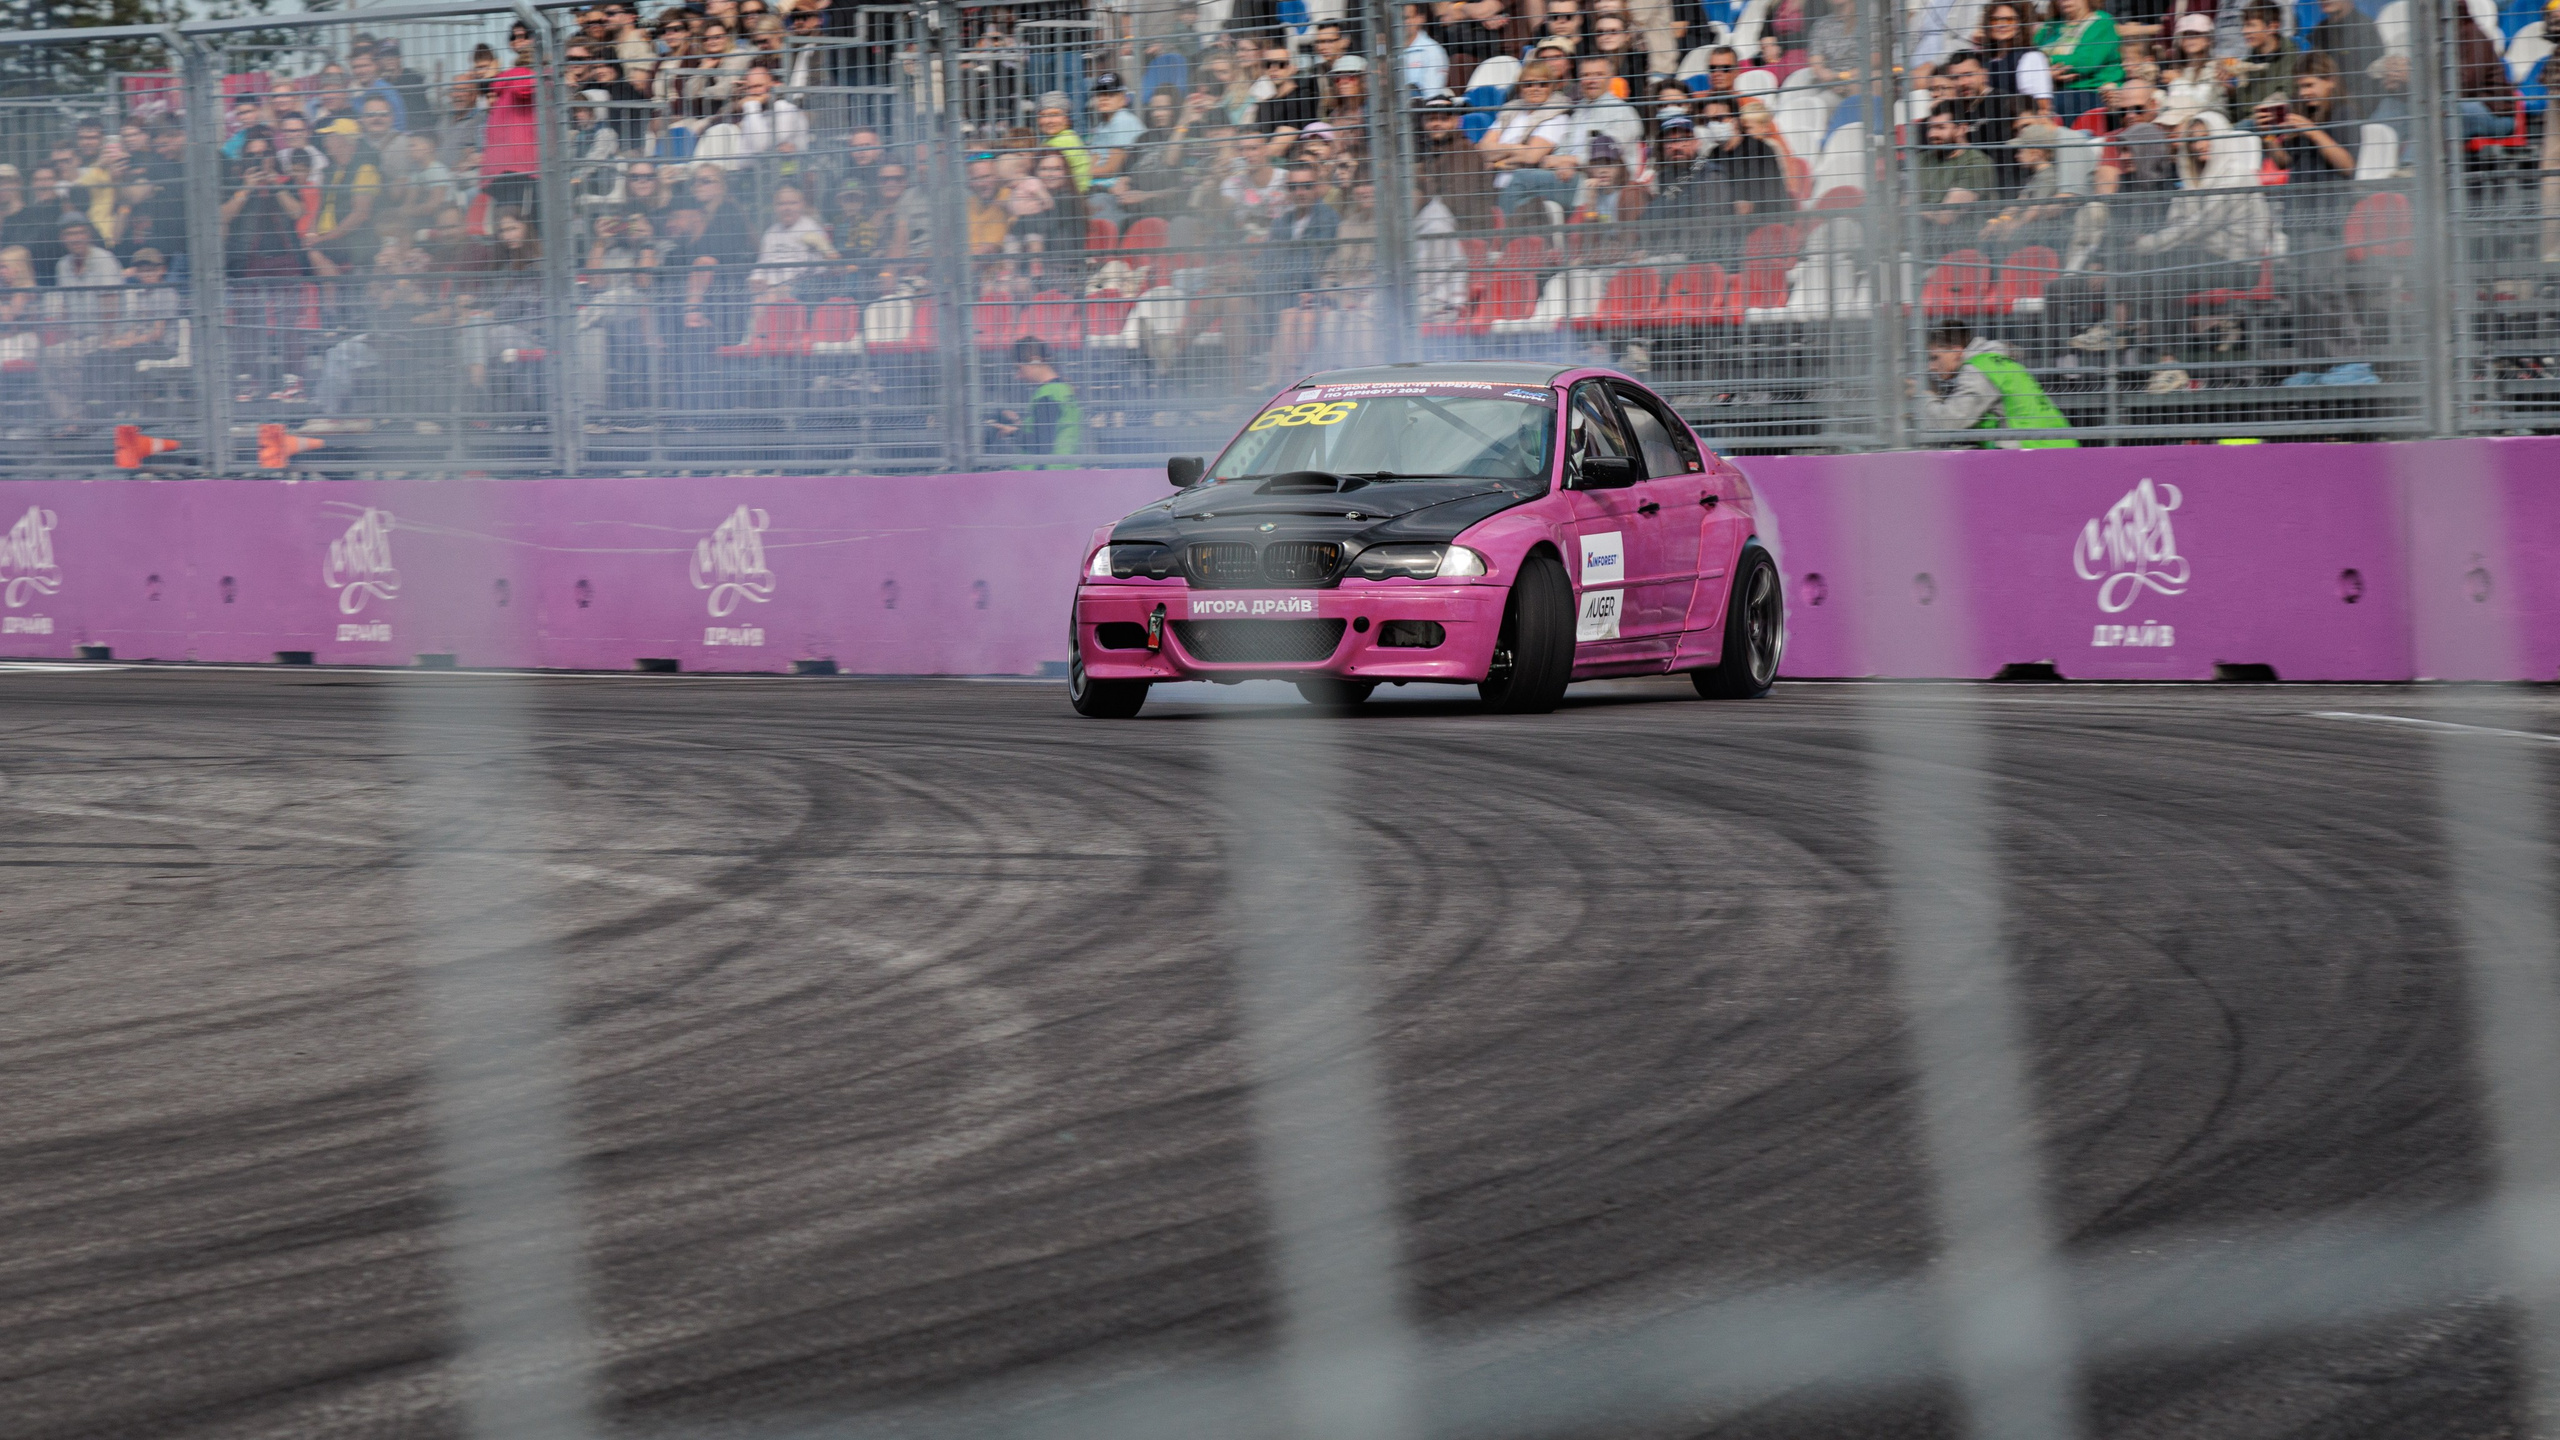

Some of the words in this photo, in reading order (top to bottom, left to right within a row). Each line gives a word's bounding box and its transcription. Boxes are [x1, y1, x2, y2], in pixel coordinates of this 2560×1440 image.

[1343, 388, 1395, 397] ДРИФТУ
[1249, 402, 1358, 431] 686
[1587, 552, 1617, 568] KINFOREST
[1193, 601, 1248, 614] ИГОРА
[1252, 597, 1313, 615] ДРАЙВ
[1586, 596, 1615, 618] AUGER
